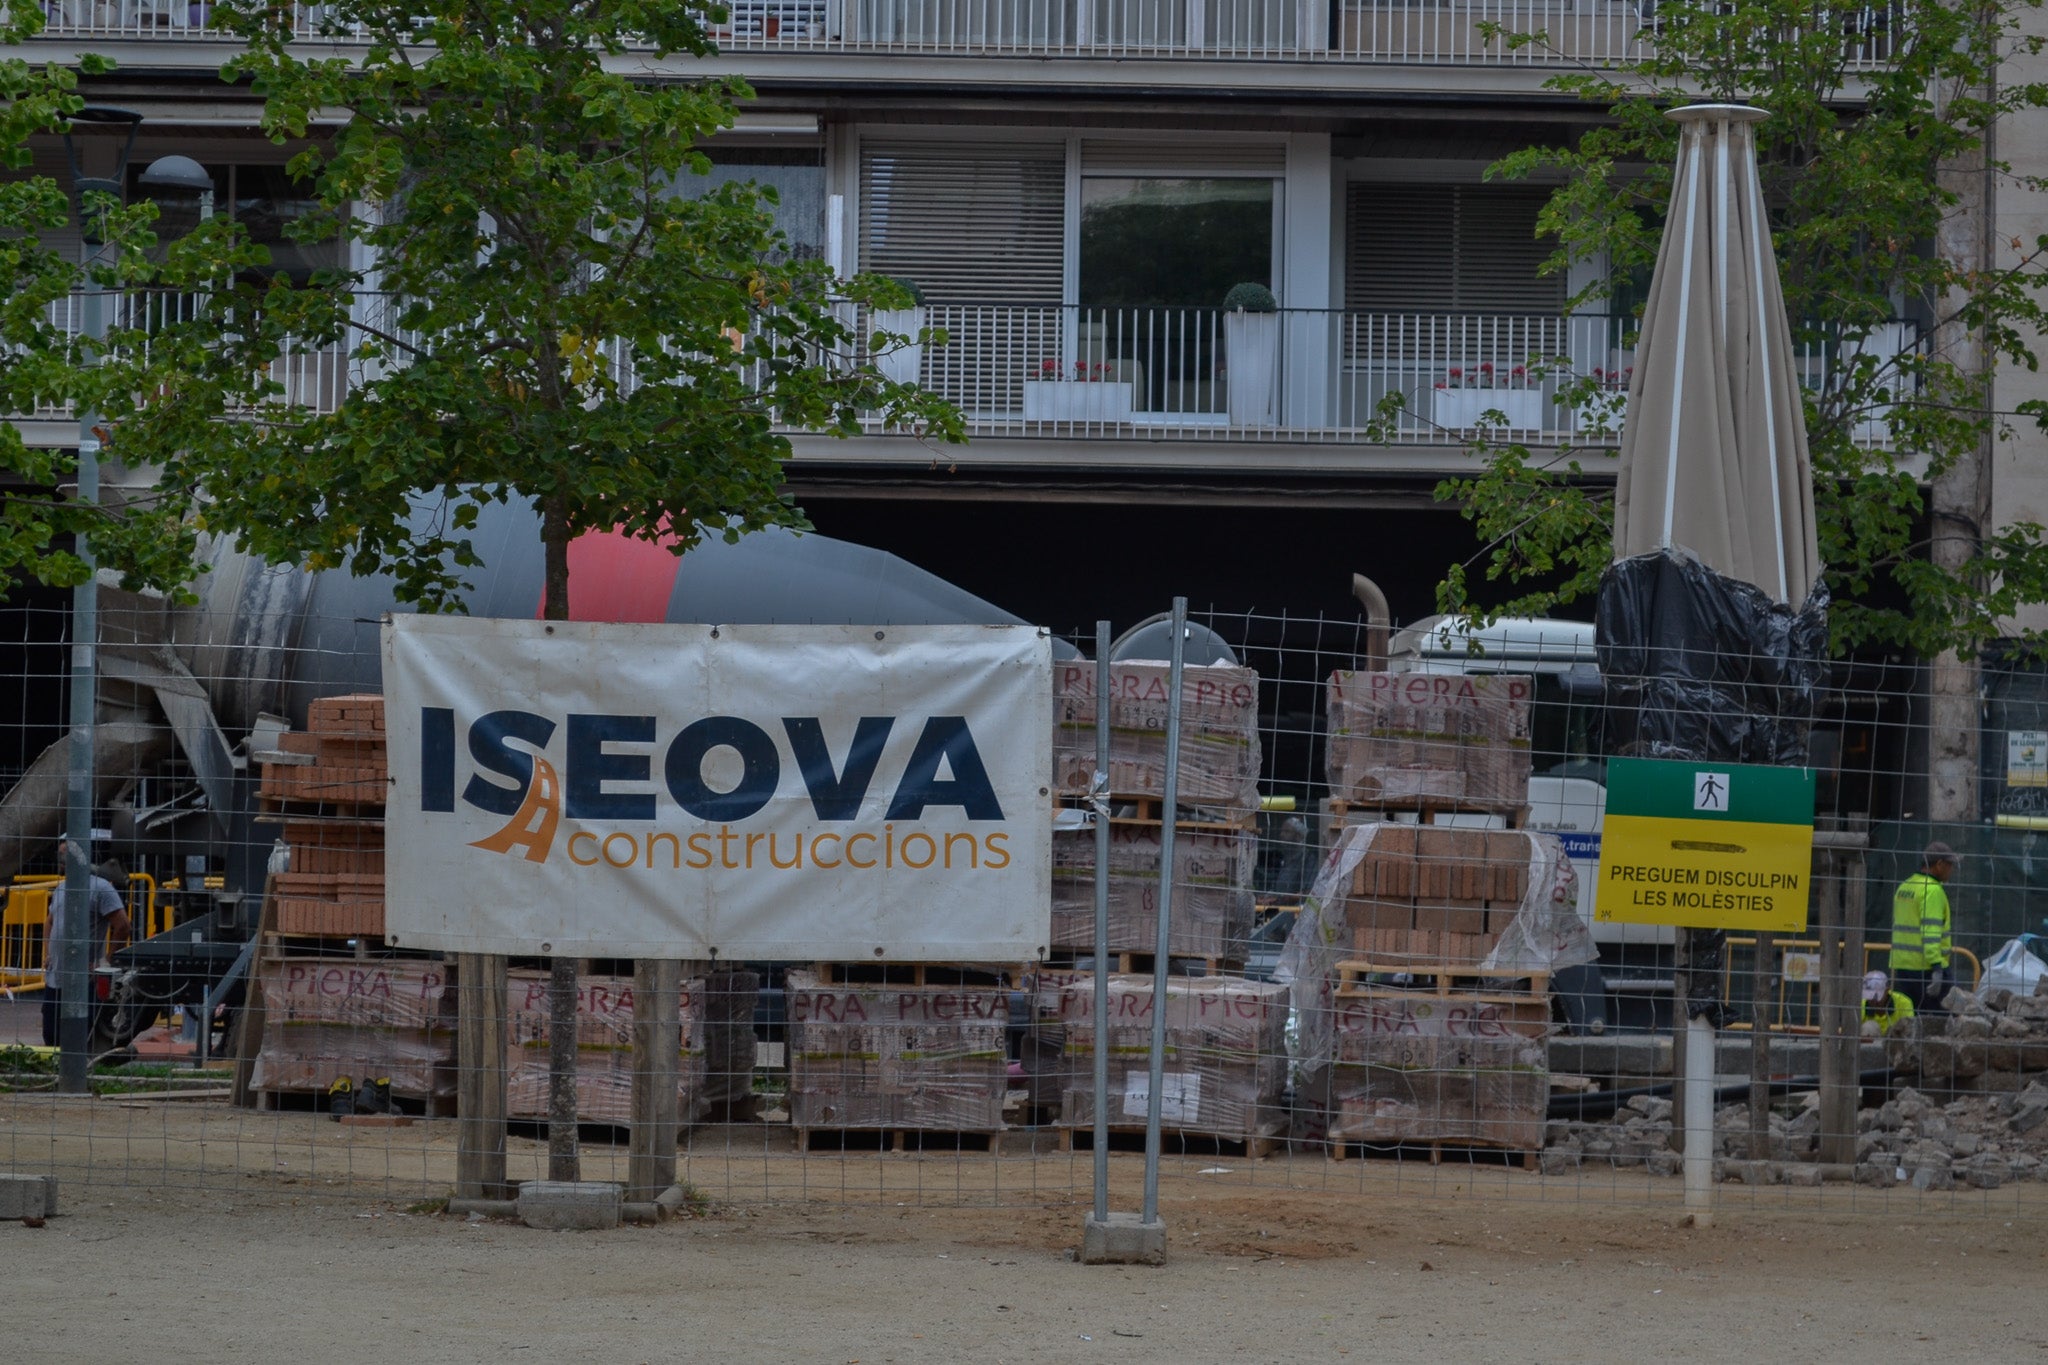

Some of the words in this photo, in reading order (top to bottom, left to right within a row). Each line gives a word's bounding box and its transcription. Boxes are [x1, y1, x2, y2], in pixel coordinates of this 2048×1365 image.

[420, 706, 1006, 822] ISEOVA
[567, 823, 1012, 870] construccions
[1610, 866, 1699, 885] PREGUEM
[1705, 870, 1798, 890] DISCULPIN
[1633, 890, 1666, 906] LES
[1672, 889, 1774, 911] MOLÈSTIES
